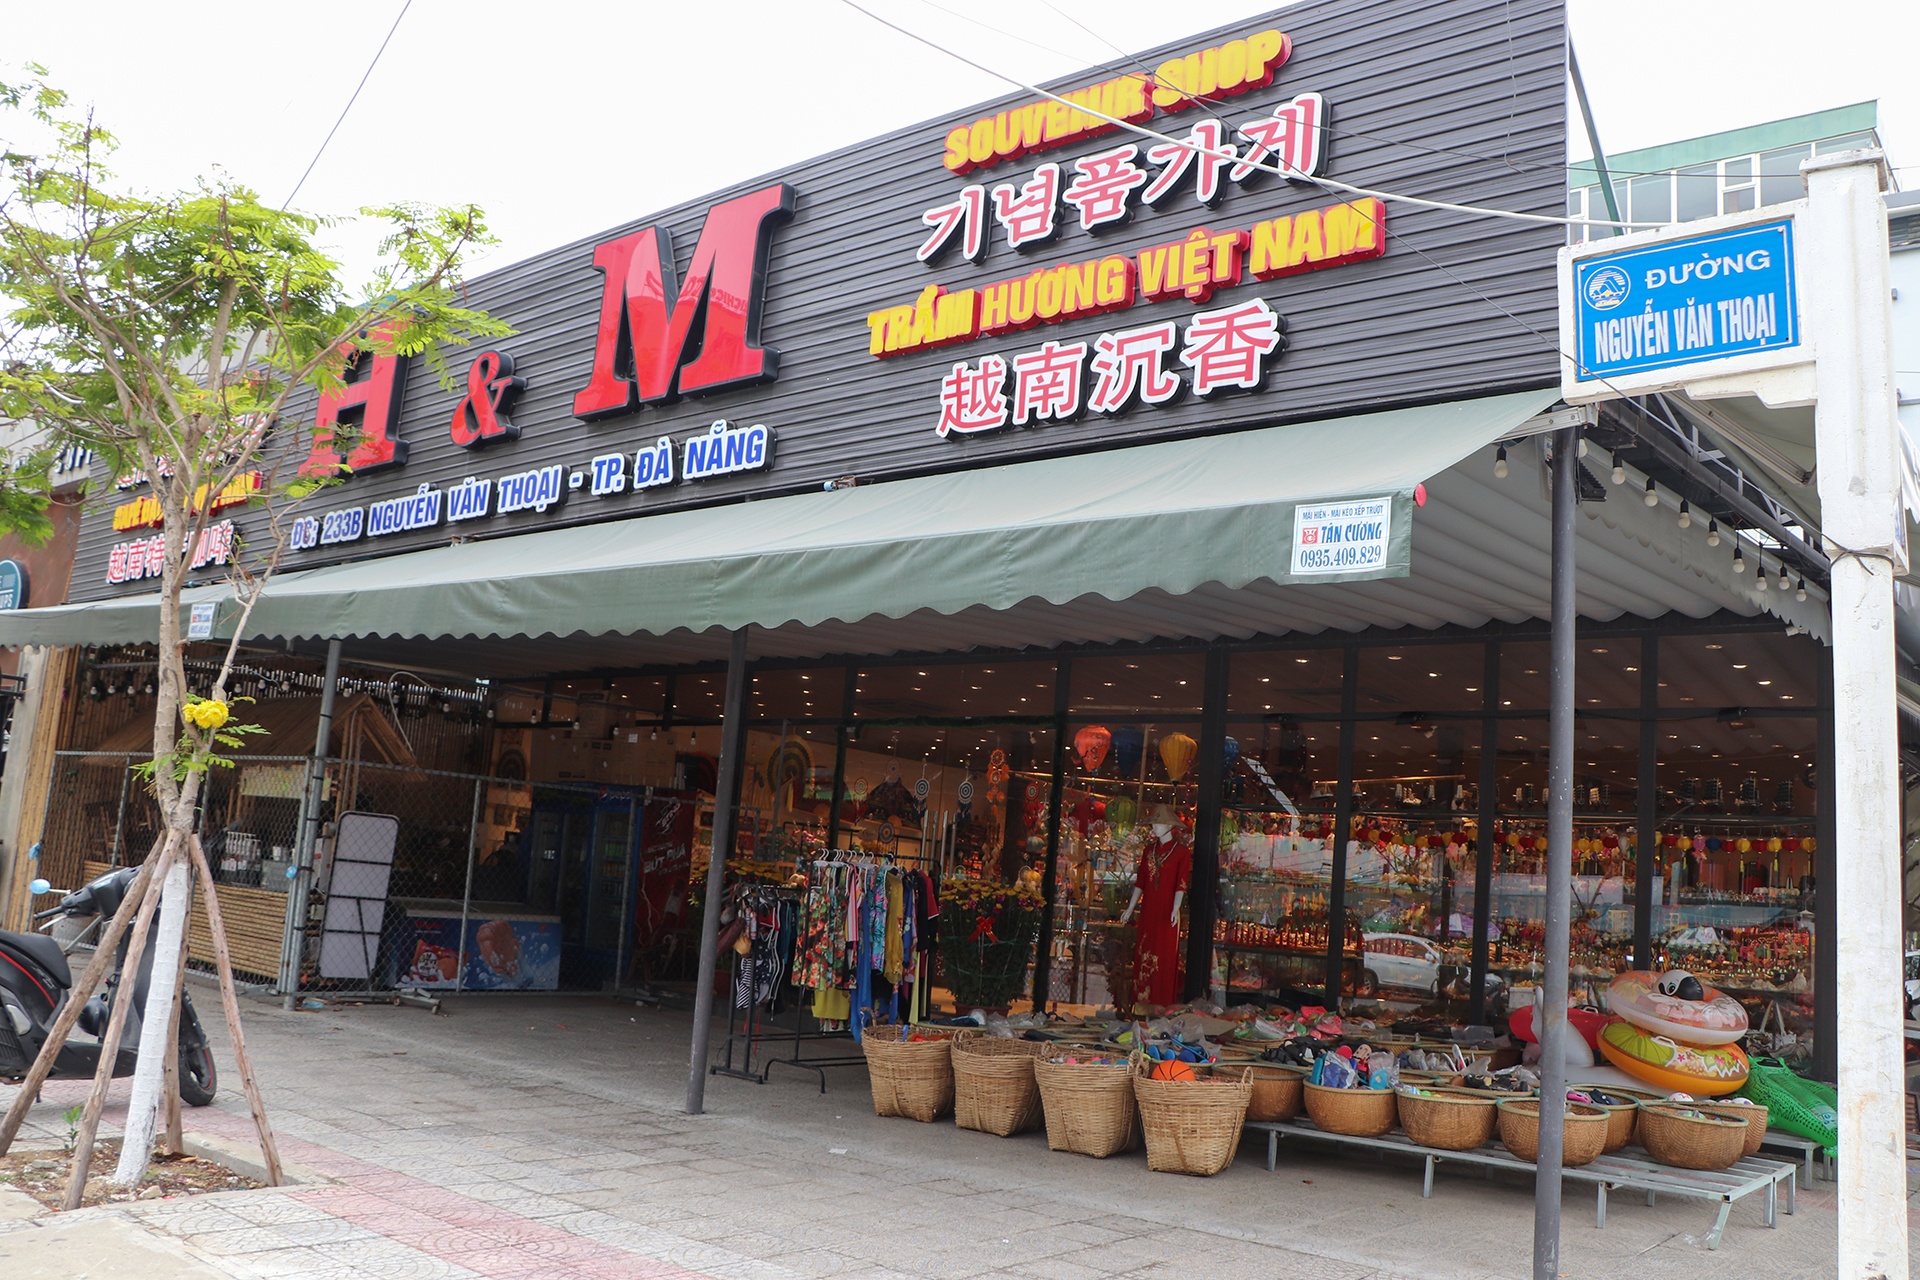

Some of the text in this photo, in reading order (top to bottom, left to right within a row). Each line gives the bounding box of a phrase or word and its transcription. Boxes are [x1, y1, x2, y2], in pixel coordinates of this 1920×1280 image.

[944, 30, 1285, 170] SOUVENIR SHOP
[917, 93, 1323, 262] 기념품가게
[450, 349, 516, 448] &
[573, 182, 783, 416] M
[980, 256, 1132, 331] HƯƠNG
[1137, 228, 1239, 299] VIỆT
[1248, 197, 1376, 275] NAM
[1595, 293, 1777, 363] NGUYỄN VĂN THOẠI
[1645, 250, 1771, 289] ĐƯỜNG
[937, 298, 1278, 438] 越南沉香
[321, 507, 364, 544] 233B
[368, 483, 441, 536] NGUYỄN
[448, 477, 492, 521] VĂN
[498, 465, 562, 513] THOẠI
[592, 453, 626, 495] TP.
[634, 436, 673, 489] ĐÀ
[683, 420, 767, 479] NẴNG
[1300, 545, 1381, 568] 0935.409.829
